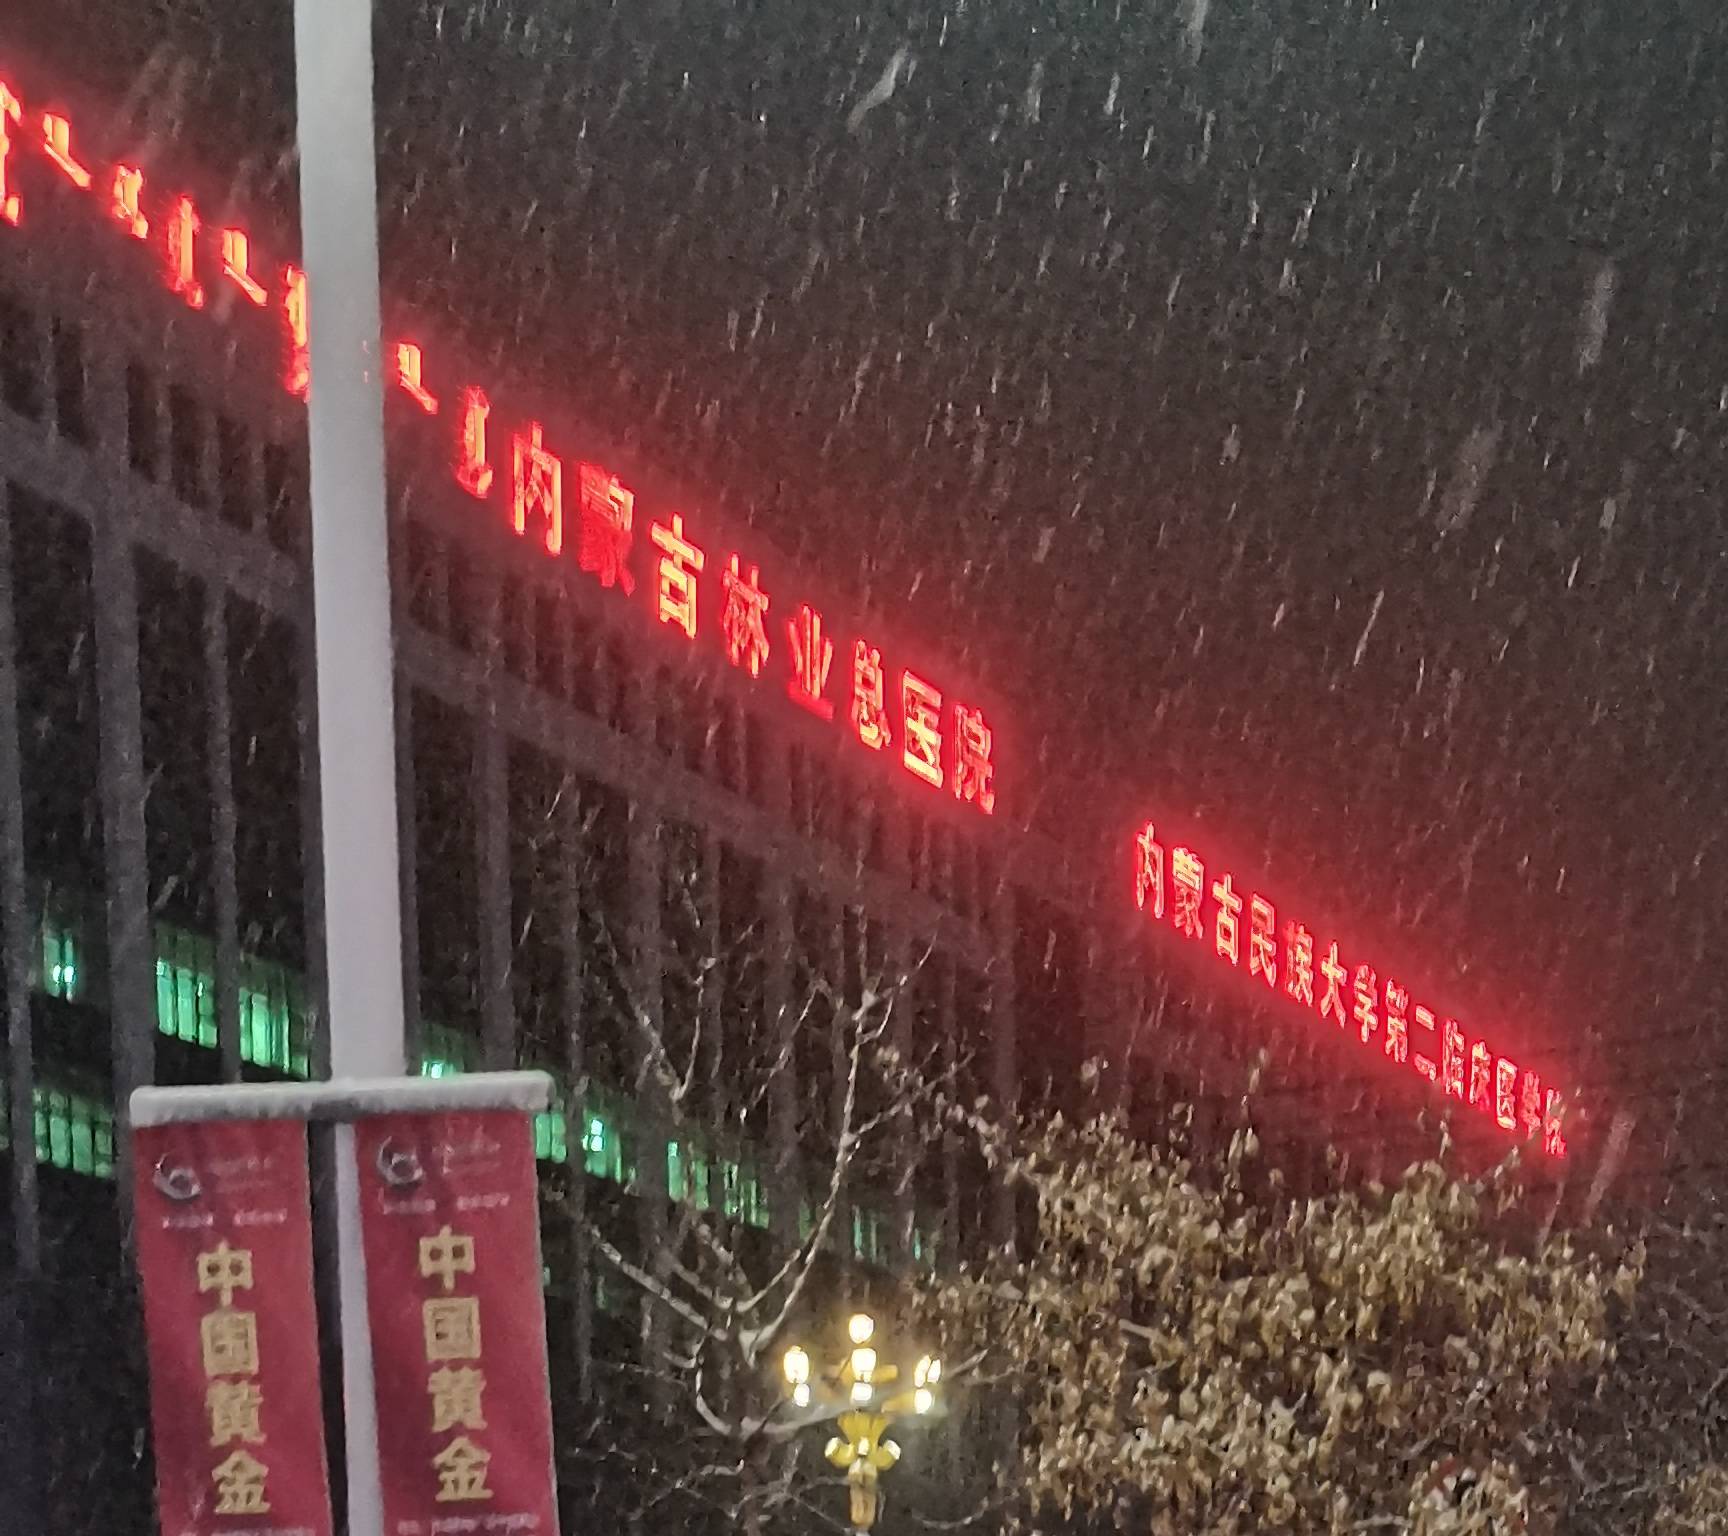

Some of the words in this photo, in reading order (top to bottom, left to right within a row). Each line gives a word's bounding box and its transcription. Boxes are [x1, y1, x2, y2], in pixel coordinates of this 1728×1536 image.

[511, 420, 996, 816] 内蒙古林业总医院
